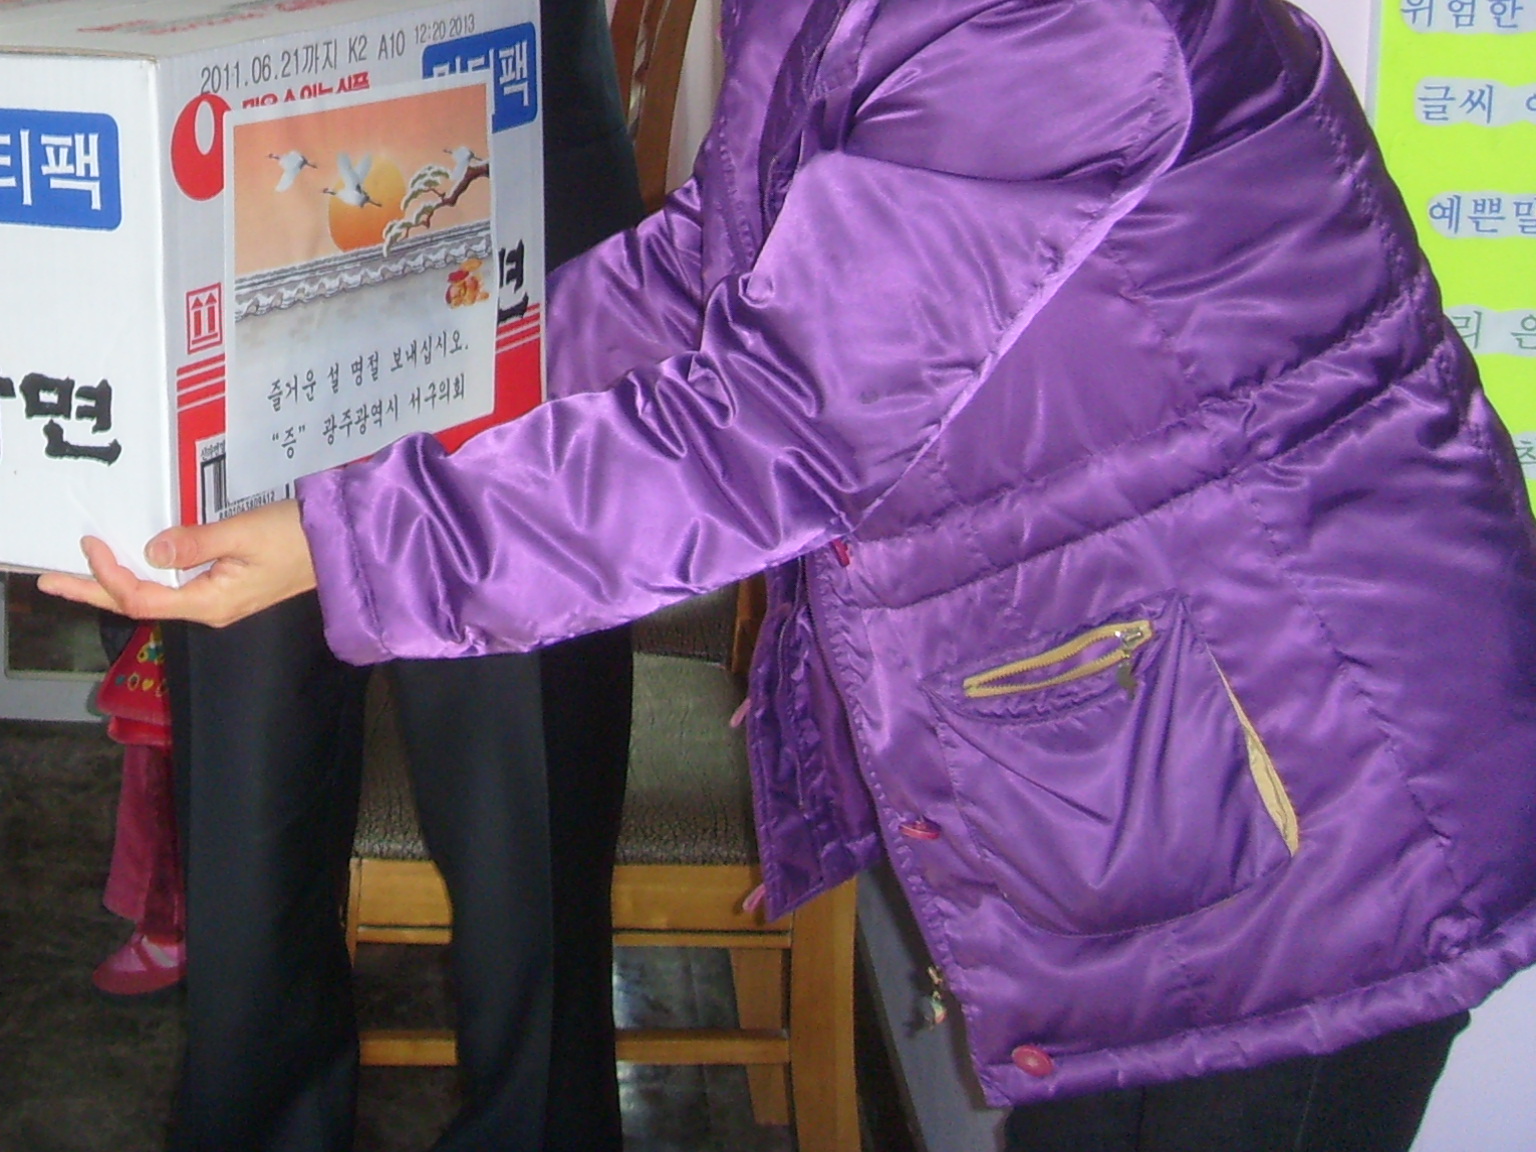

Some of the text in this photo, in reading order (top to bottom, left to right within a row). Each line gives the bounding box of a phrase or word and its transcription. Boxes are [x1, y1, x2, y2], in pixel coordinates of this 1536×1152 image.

[348, 36, 368, 63] K2
[378, 30, 406, 61] A10
[1417, 84, 1493, 124] 글씨
[267, 329, 469, 412] 즐거운 설 명절 보내십시오.
[322, 394, 399, 445] 광주광역시
[409, 373, 465, 414] 서구의회
